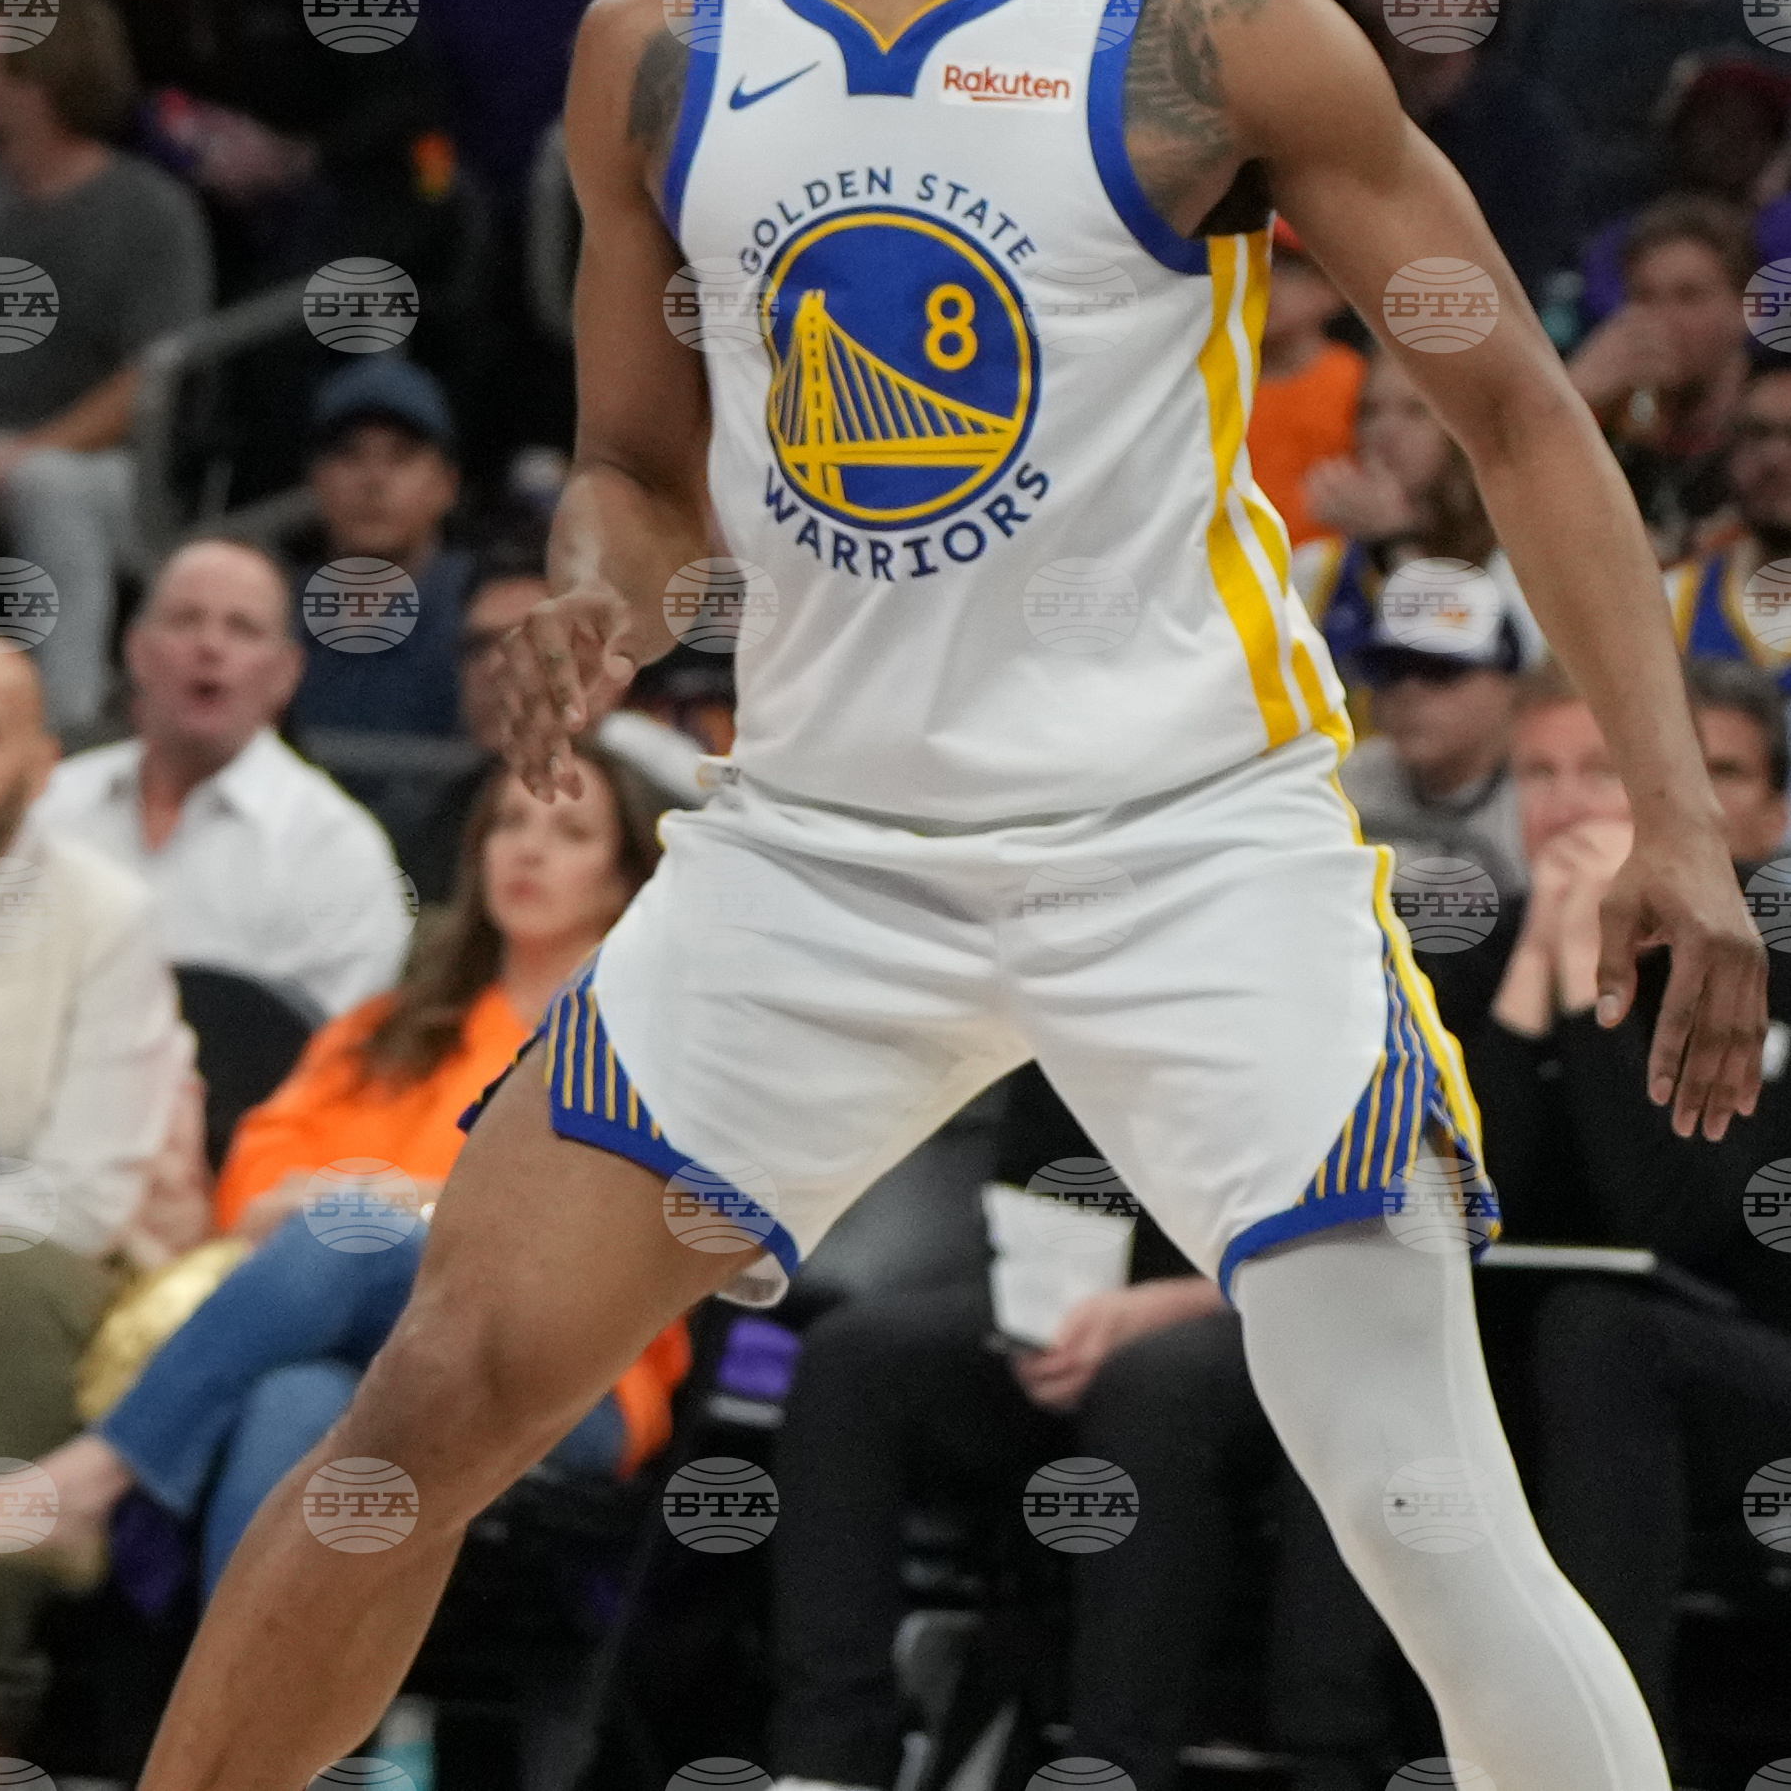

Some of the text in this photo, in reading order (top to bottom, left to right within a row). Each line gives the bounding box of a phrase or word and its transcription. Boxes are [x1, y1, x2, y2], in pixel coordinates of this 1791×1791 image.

[943, 64, 1071, 100] Rakuten
[739, 166, 1038, 275] GOLDEN STATE
[923, 281, 980, 373] 8
[763, 461, 1052, 583] WARRIORS
